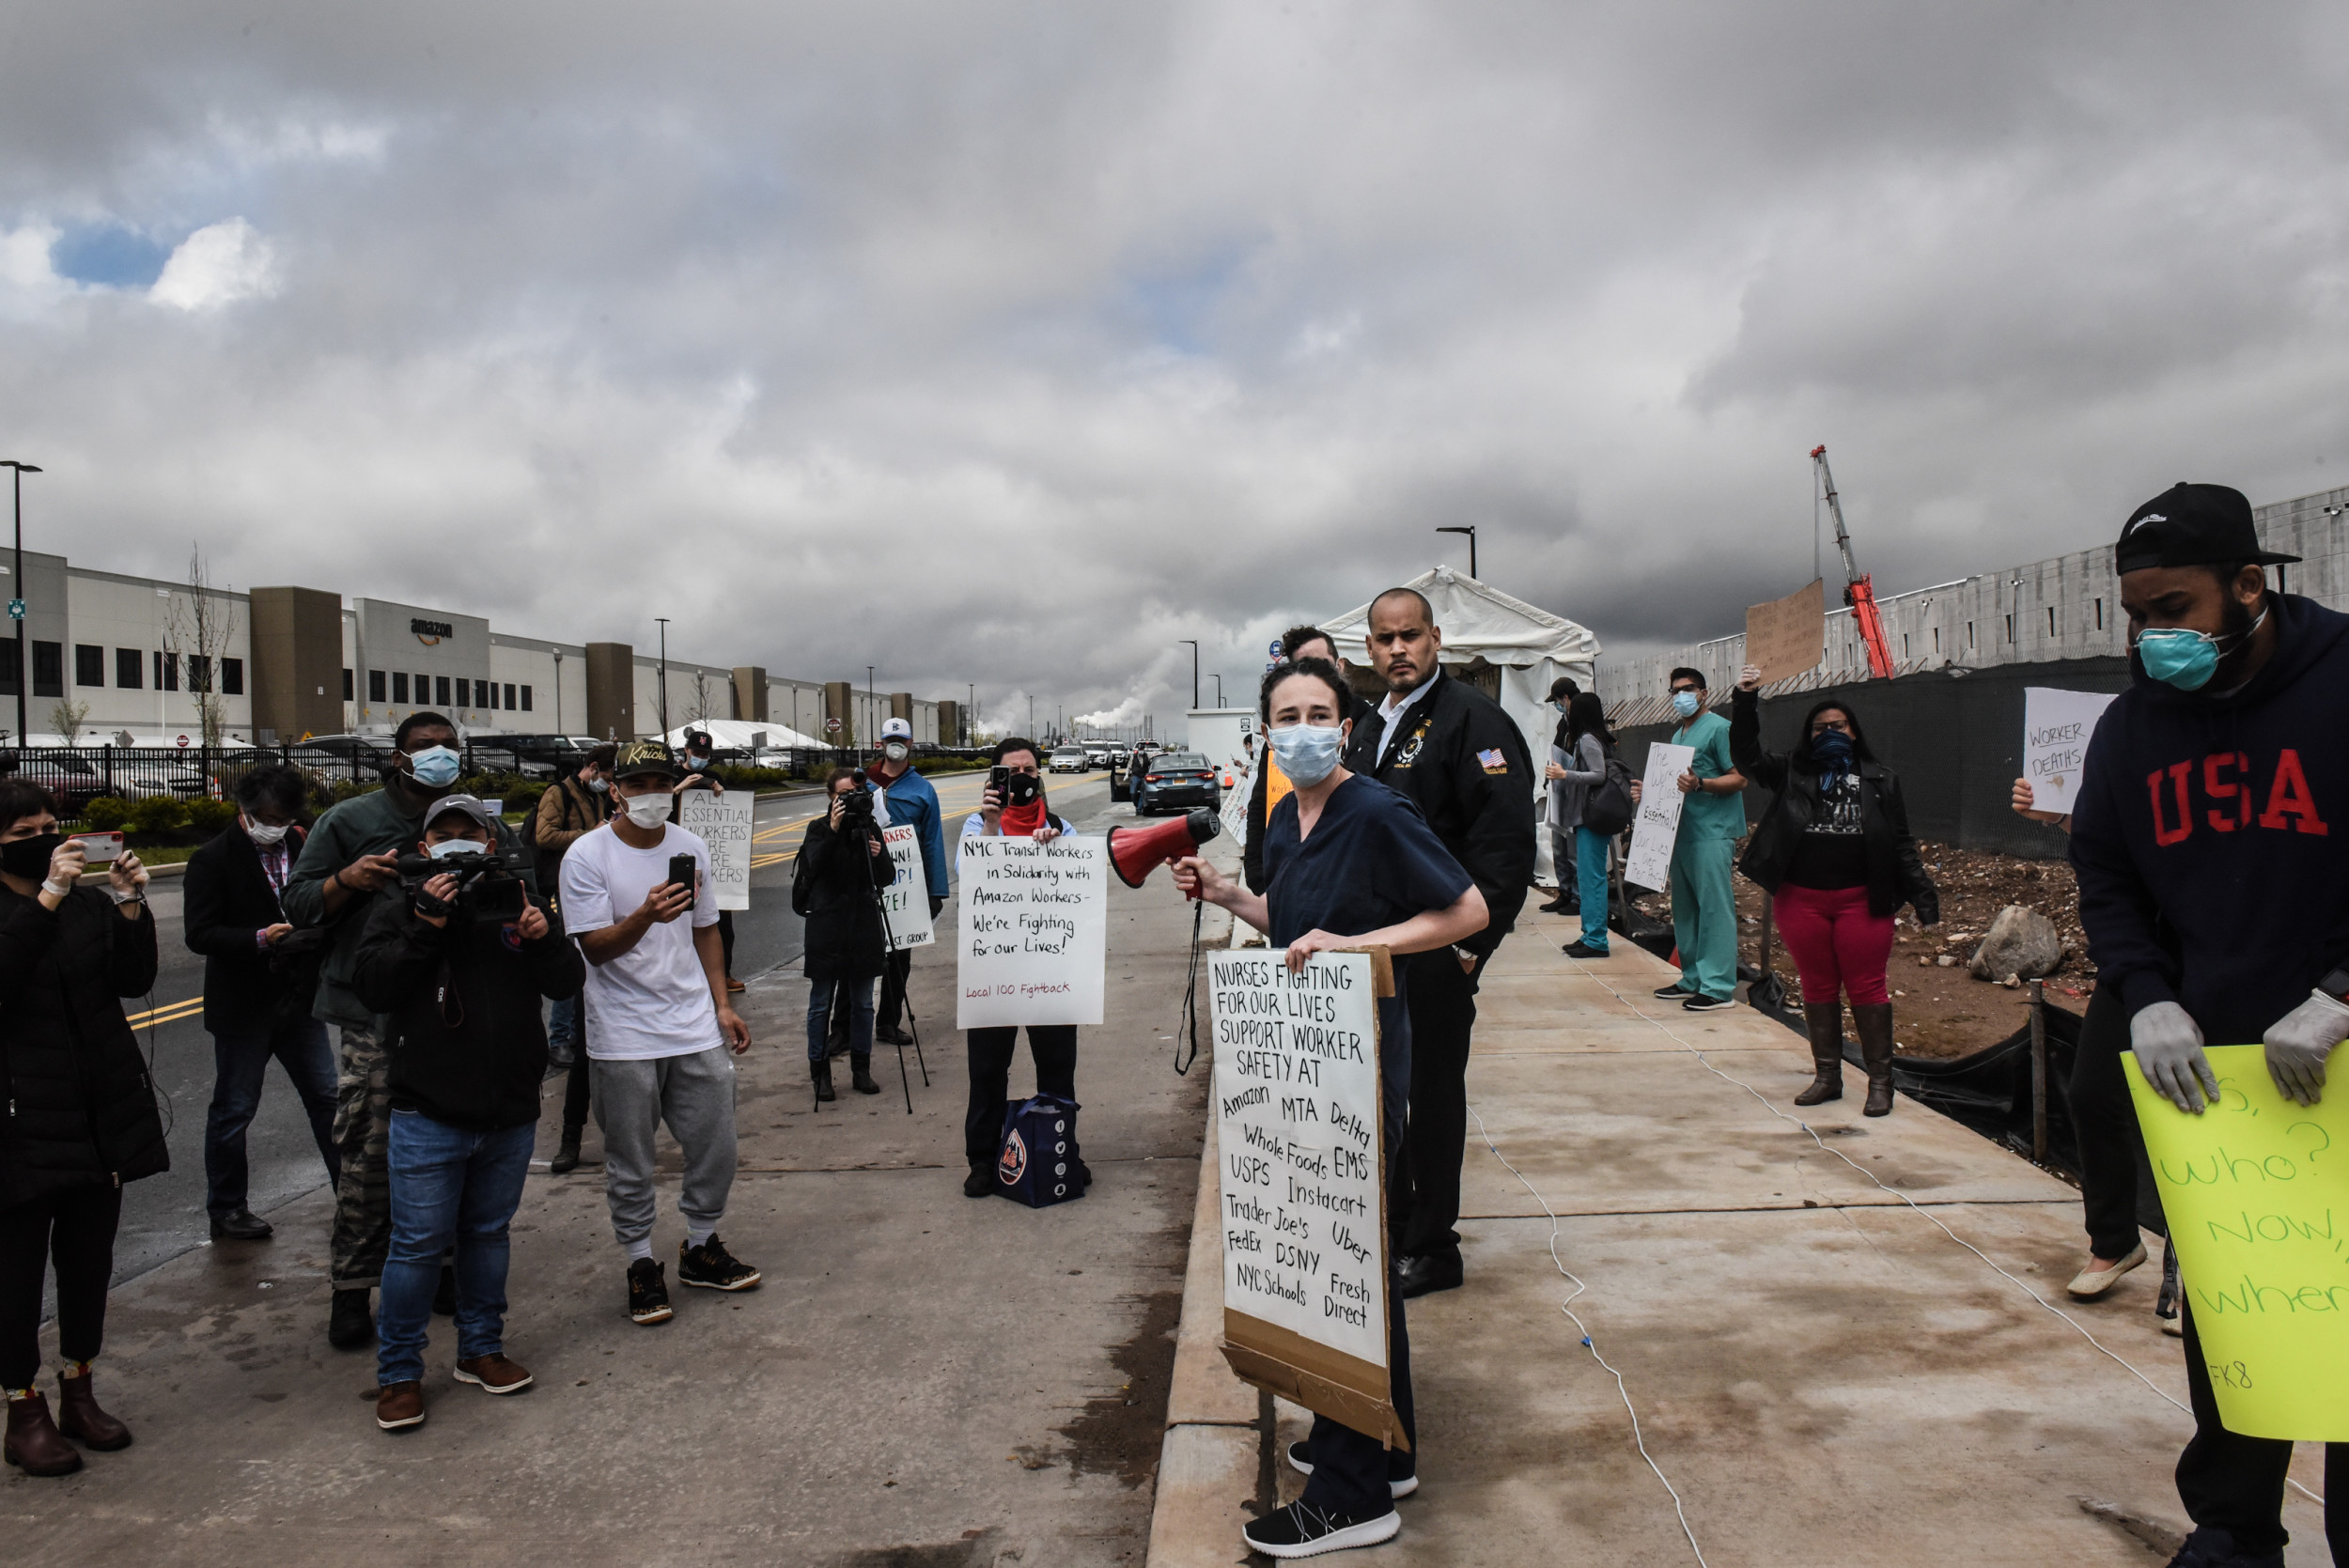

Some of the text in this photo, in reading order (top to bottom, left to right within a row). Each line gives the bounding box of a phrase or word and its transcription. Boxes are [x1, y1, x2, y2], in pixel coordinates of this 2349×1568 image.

[411, 618, 452, 639] amazon
[2030, 722, 2086, 747] WORKER
[627, 746, 667, 765] Knicks
[1652, 744, 1669, 767] The
[2032, 749, 2081, 776] DEATHS
[692, 792, 731, 806] ALL
[2147, 749, 2328, 847] USA
[683, 808, 752, 825] ESSENTIAL
[708, 840, 725, 853] RE
[884, 828, 912, 844] RKERS
[964, 841, 1094, 860] NYC Transit Workers
[711, 868, 744, 883] KERS
[987, 862, 1090, 886] in Solidarity with
[973, 887, 1023, 906] Amazon
[907, 932, 928, 945] GROUP
[973, 913, 1075, 939] We're Fighting
[972, 936, 1066, 956] for our Lives!
[1215, 961, 1353, 990] NURSES FIGHTING
[966, 981, 1071, 998] Local 100 Fightback
[1218, 991, 1335, 1022] FOR OUR LIVES
[1221, 1018, 1363, 1063] SUPPORT WORKER
[1237, 1050, 1321, 1088] SAFETY AT
[1223, 1086, 1370, 1150] Amazon MTA Delta
[1244, 1124, 1368, 1180] Whole Foods EMS
[1231, 1154, 1366, 1218] USPS Instacart
[1226, 1193, 1372, 1265] Trader Joe's Uber
[1228, 1229, 1320, 1276] FedEx DSNY
[1237, 1263, 1370, 1306] NYC Schools Fresh
[1325, 1295, 1366, 1328] Direct
[2209, 1360, 2253, 1389] FK8
